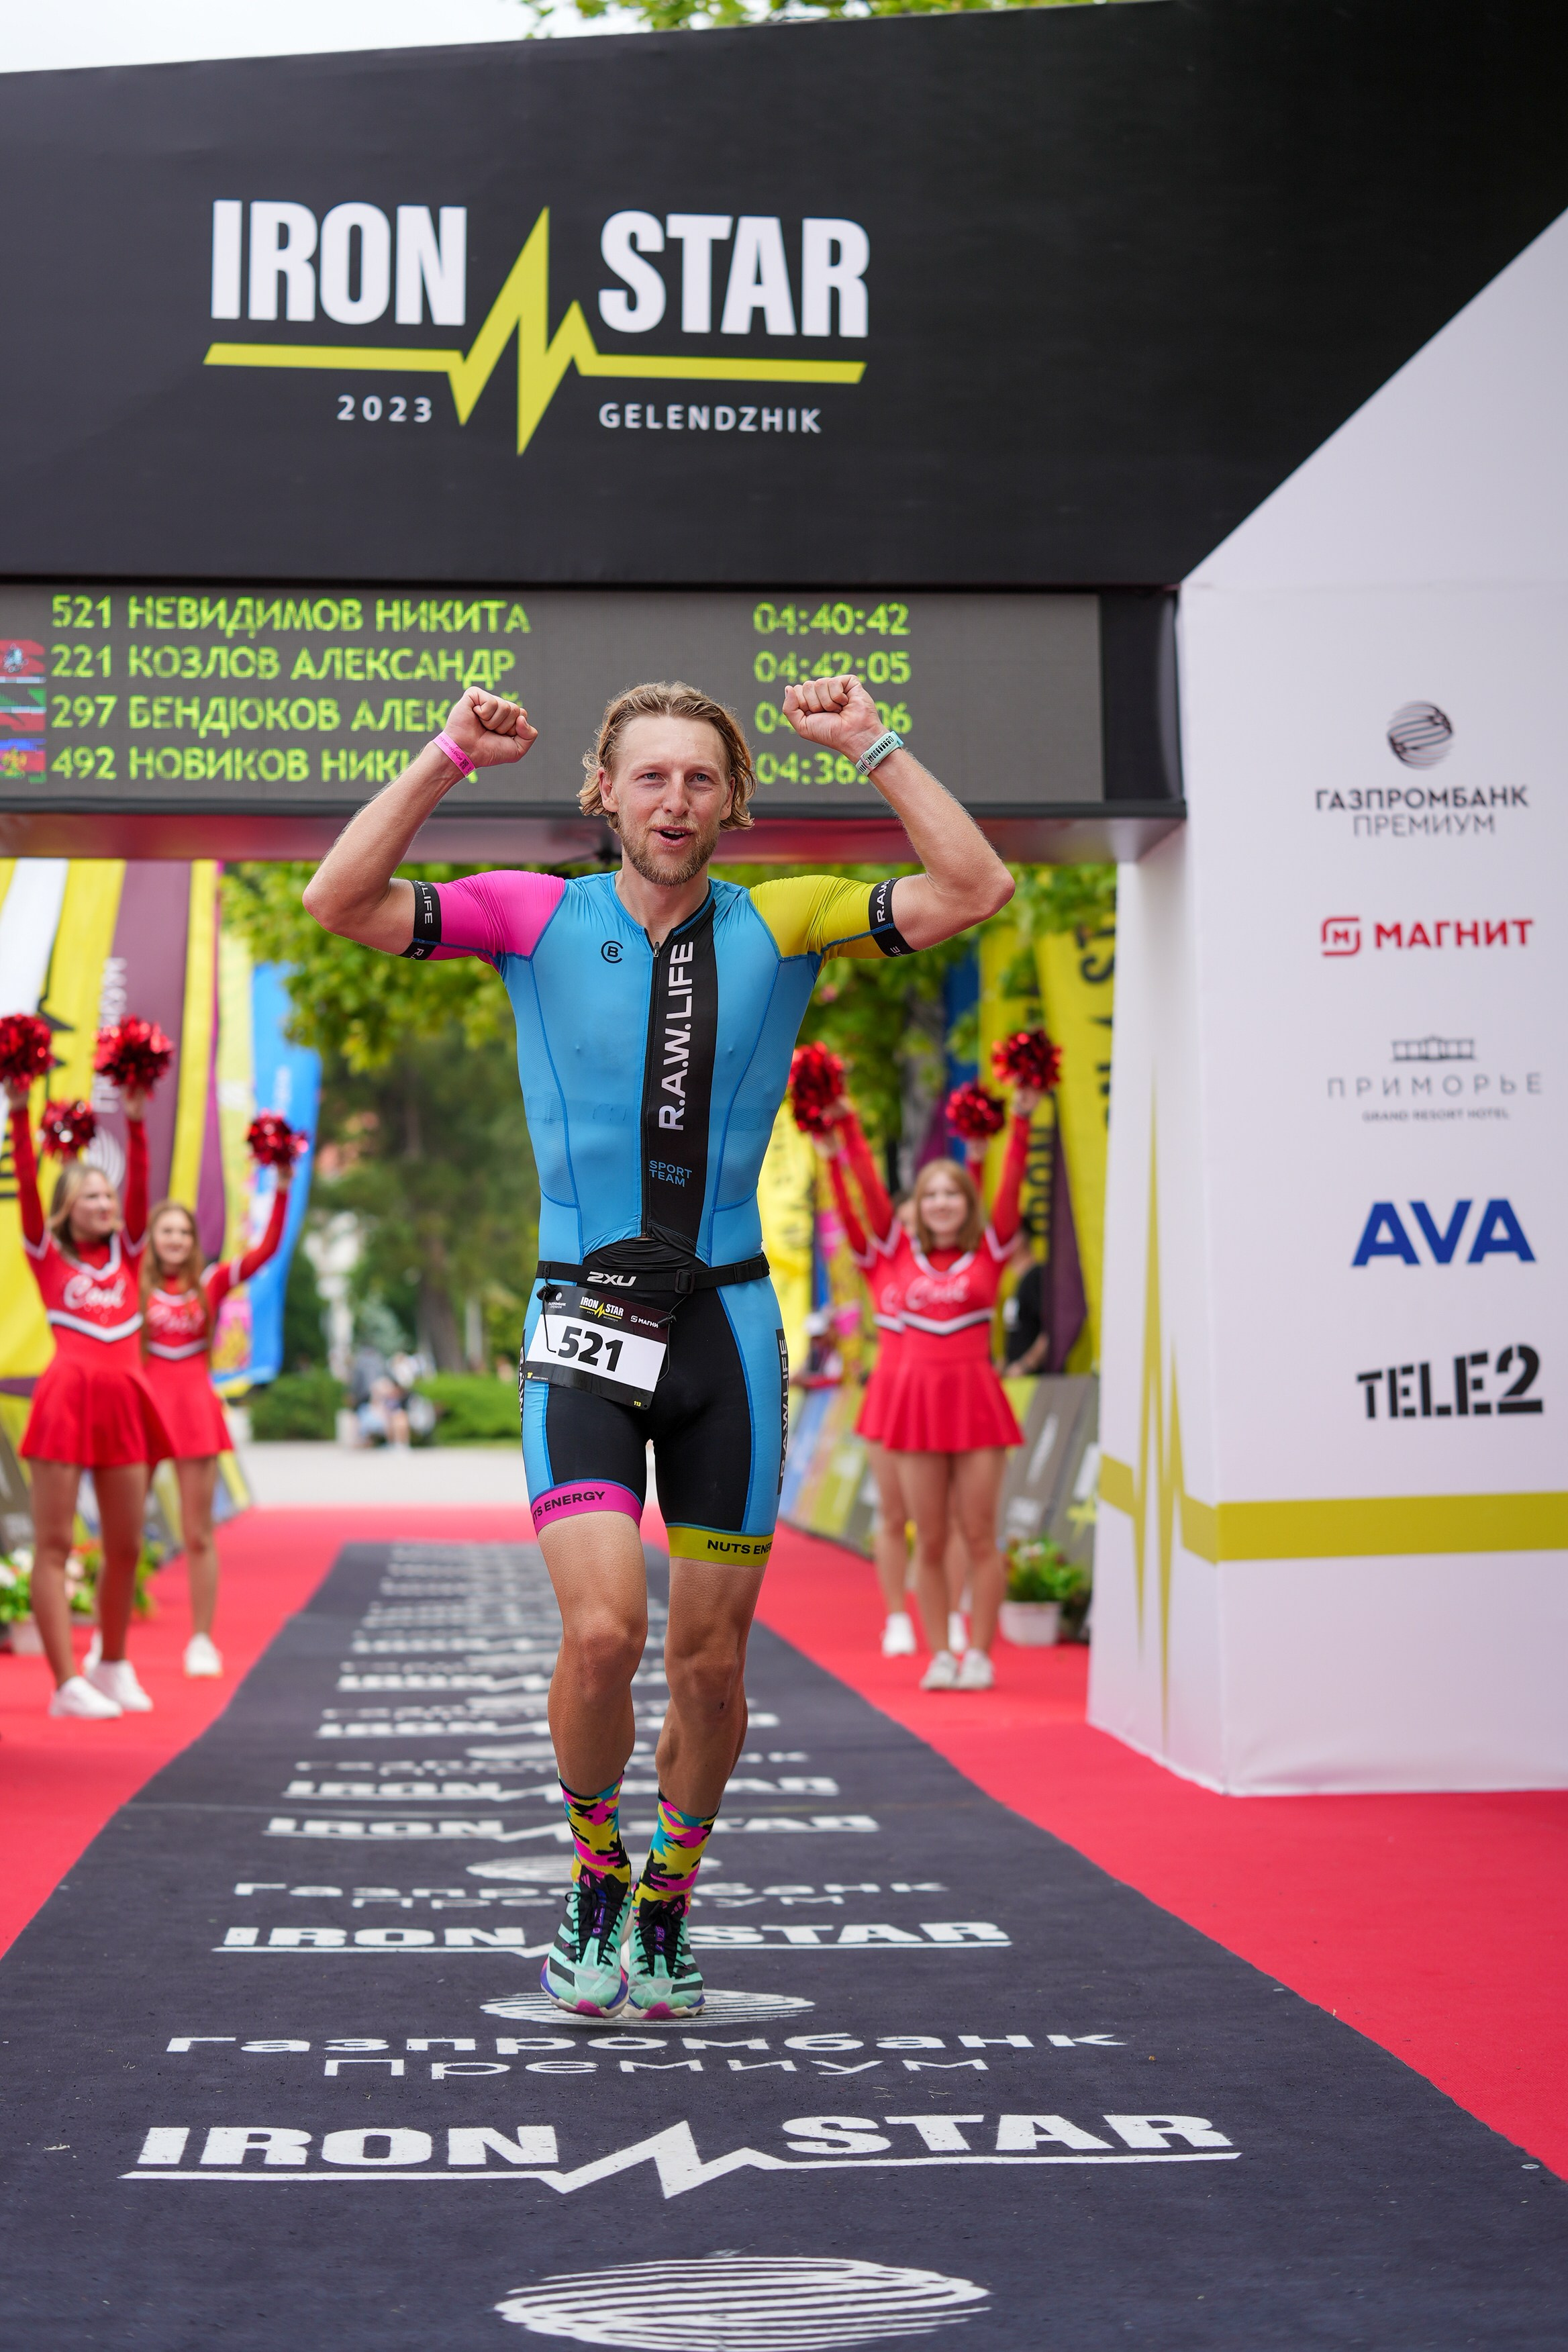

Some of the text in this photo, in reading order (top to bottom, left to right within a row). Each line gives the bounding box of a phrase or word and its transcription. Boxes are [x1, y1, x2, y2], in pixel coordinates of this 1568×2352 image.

[211, 199, 870, 338] IRON STAR
[337, 395, 822, 434] 2023 GELENDZHIK
[52, 595, 911, 638] 521 НЕВИДИМОВ НИКИТА 04:40:42
[50, 644, 912, 689] 221 КОЗЛОВ АЛЕКСАНДР 04:42:05
[52, 695, 116, 728] 297
[129, 697, 340, 738] БЕНДЮКОВ
[52, 747, 116, 780] 492
[130, 748, 309, 781] НОВИКОВ
[1315, 785, 1530, 811] ГАЗПРОМБАНК
[1353, 813, 1496, 837] ПРЕМИУМ
[1374, 920, 1533, 949] МАГНИТ
[658, 941, 693, 1131] R.A.W.LIFE
[1327, 1073, 1542, 1098] ПРИМОРЬЕ
[1363, 1108, 1510, 1122] GRAND RESORT HOTEL
[648, 1169, 685, 1187] TEAM
[649, 1160, 693, 1179] SPORT
[1351, 1198, 1536, 1267] AVA
[586, 1271, 636, 1287] 2XU
[580, 1296, 624, 1317] IRON STAR
[638, 1318, 659, 1328] МАГНИ
[557, 1326, 624, 1372] 521
[1357, 1343, 1544, 1419] TELE2
[544, 1491, 605, 1512] ENERGY
[707, 1540, 751, 1555] NUTS
[268, 1818, 503, 1834] IRON
[235, 1882, 949, 1899] Газпрбанк
[352, 1896, 844, 1910] Преум
[224, 1927, 526, 1947] IRON
[688, 1922, 1010, 1944] STAR
[166, 2032, 1128, 2055] Газпромбанк
[324, 2059, 989, 2079] Премиум
[137, 2115, 1235, 2165] IRON STAR
